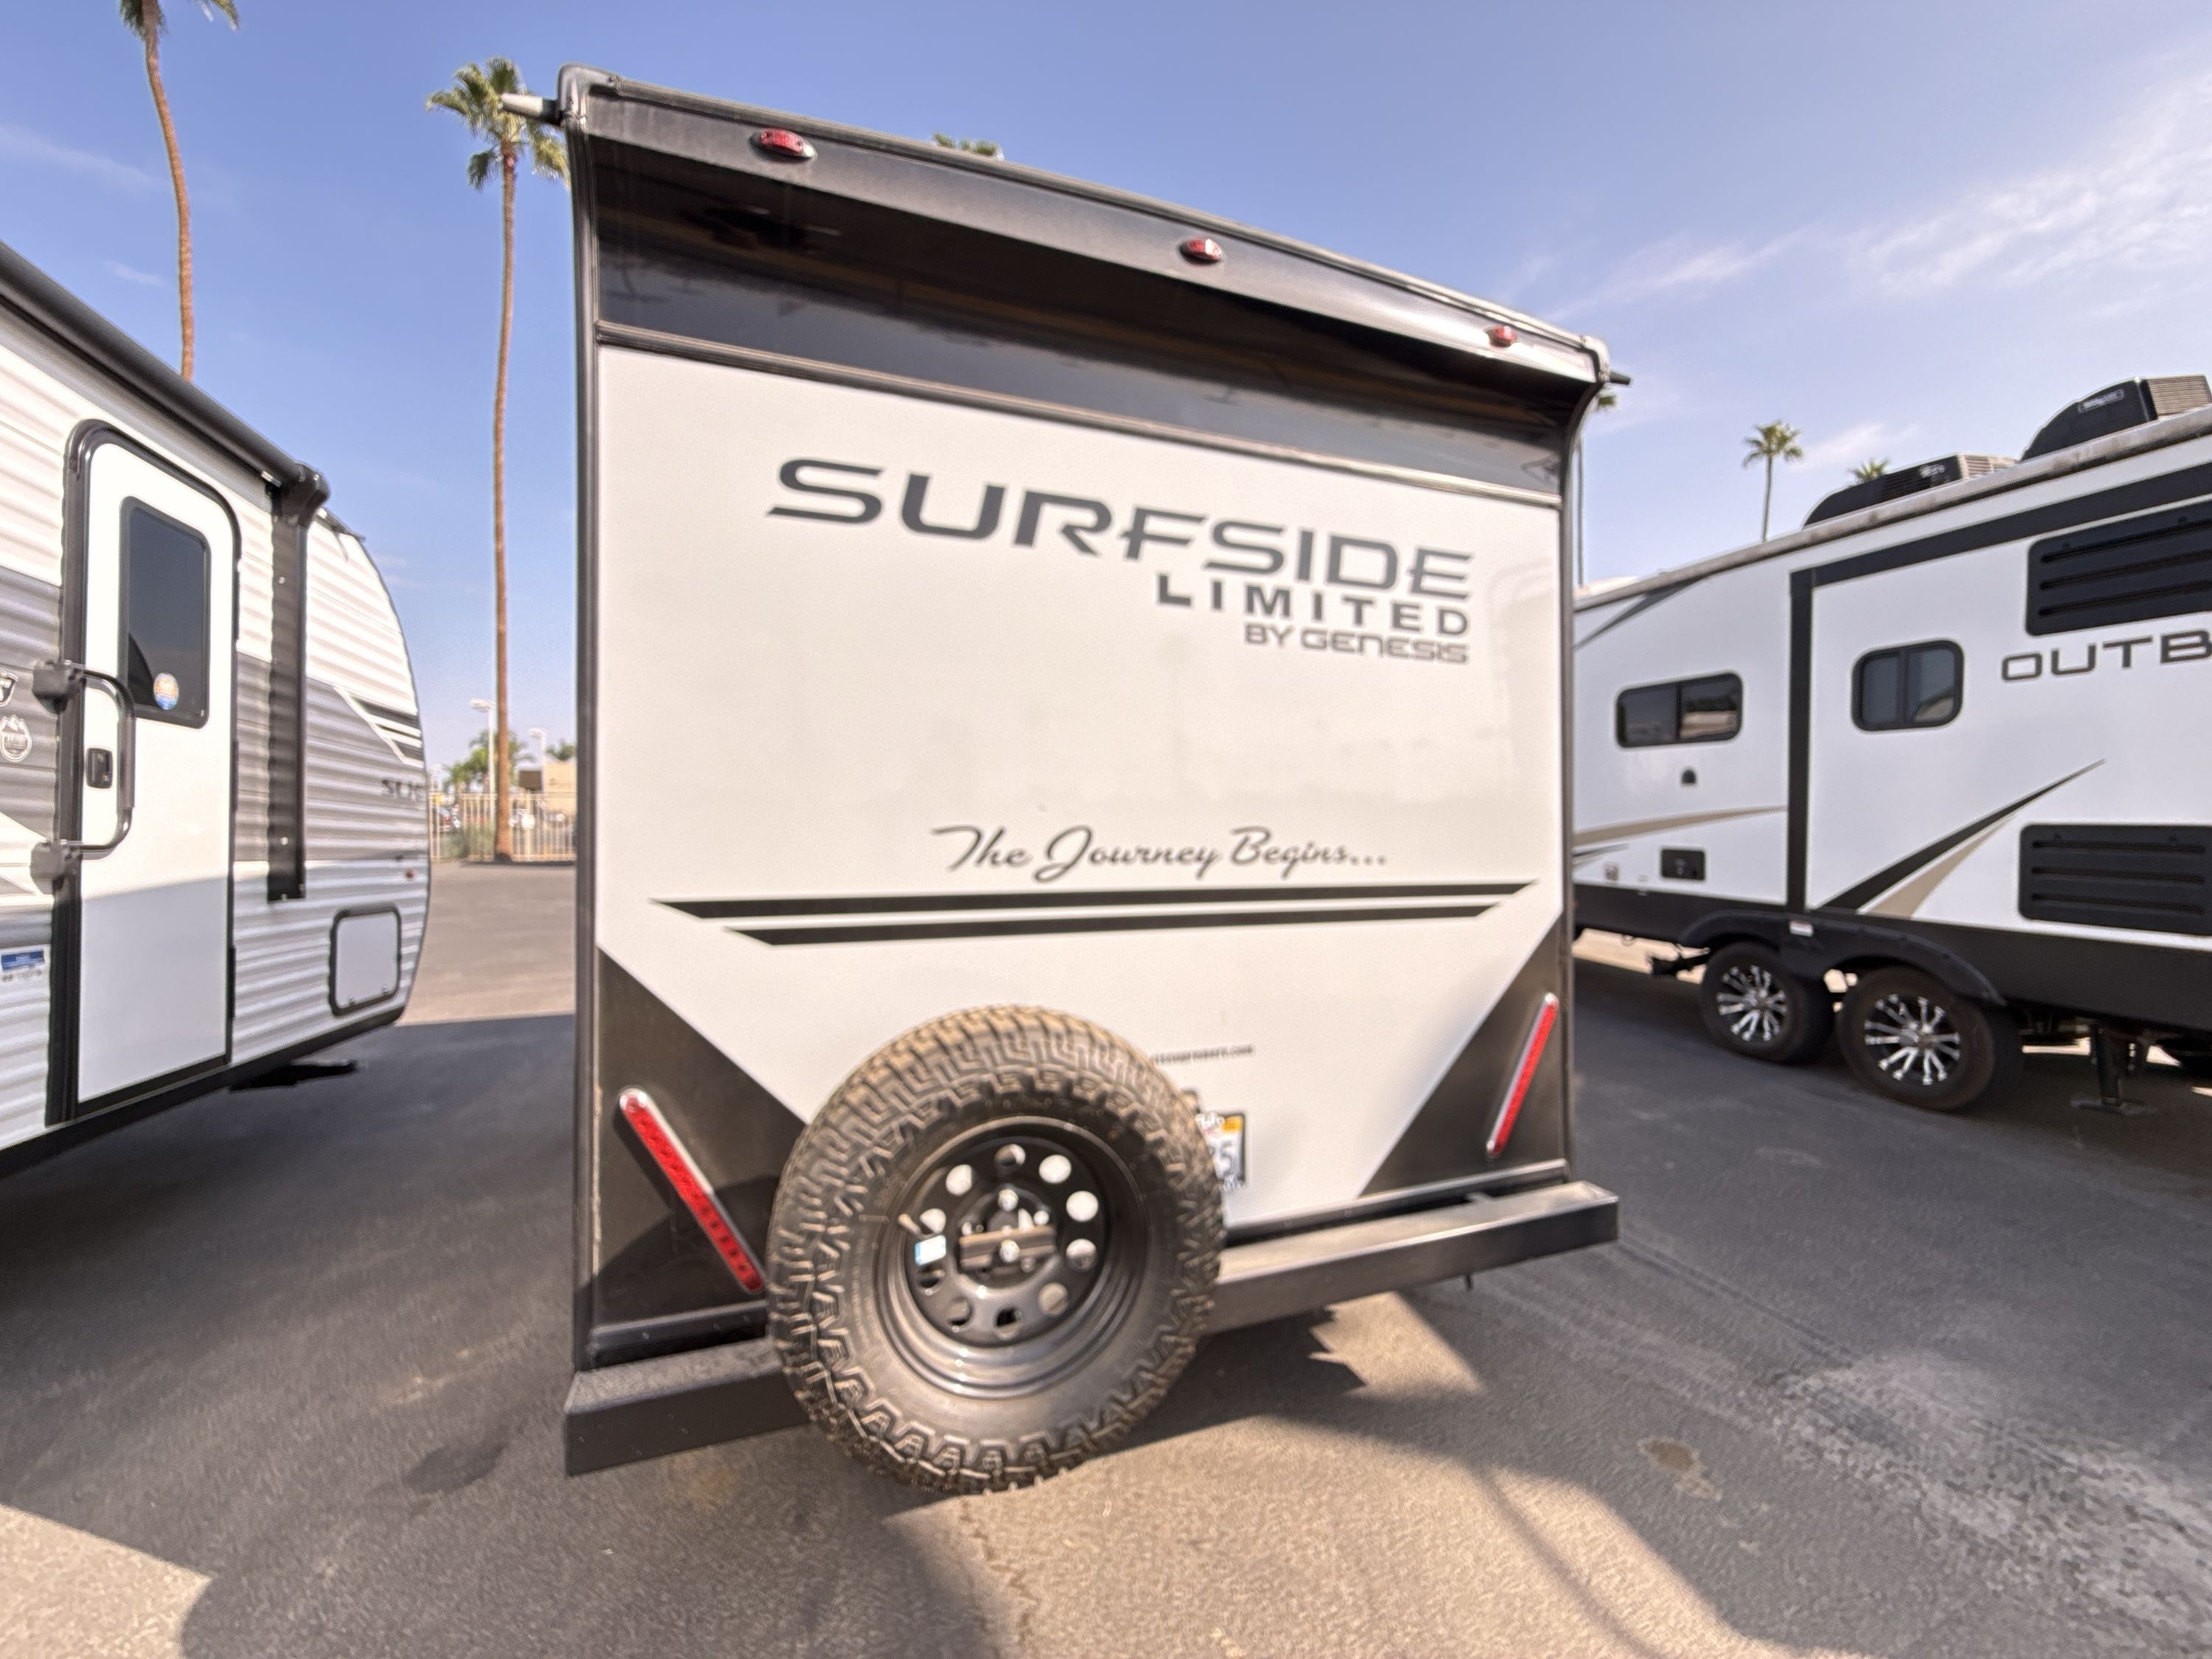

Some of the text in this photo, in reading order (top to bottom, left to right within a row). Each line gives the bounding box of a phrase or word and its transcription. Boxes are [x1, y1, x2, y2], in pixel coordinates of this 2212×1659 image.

[765, 456, 1473, 602] SURFSIDE
[1156, 571, 1470, 637] LIMITED
[1244, 623, 1469, 664] BY GENESIS
[2000, 629, 2212, 683] OUTB
[930, 824, 1386, 884] The Journey Begins...
